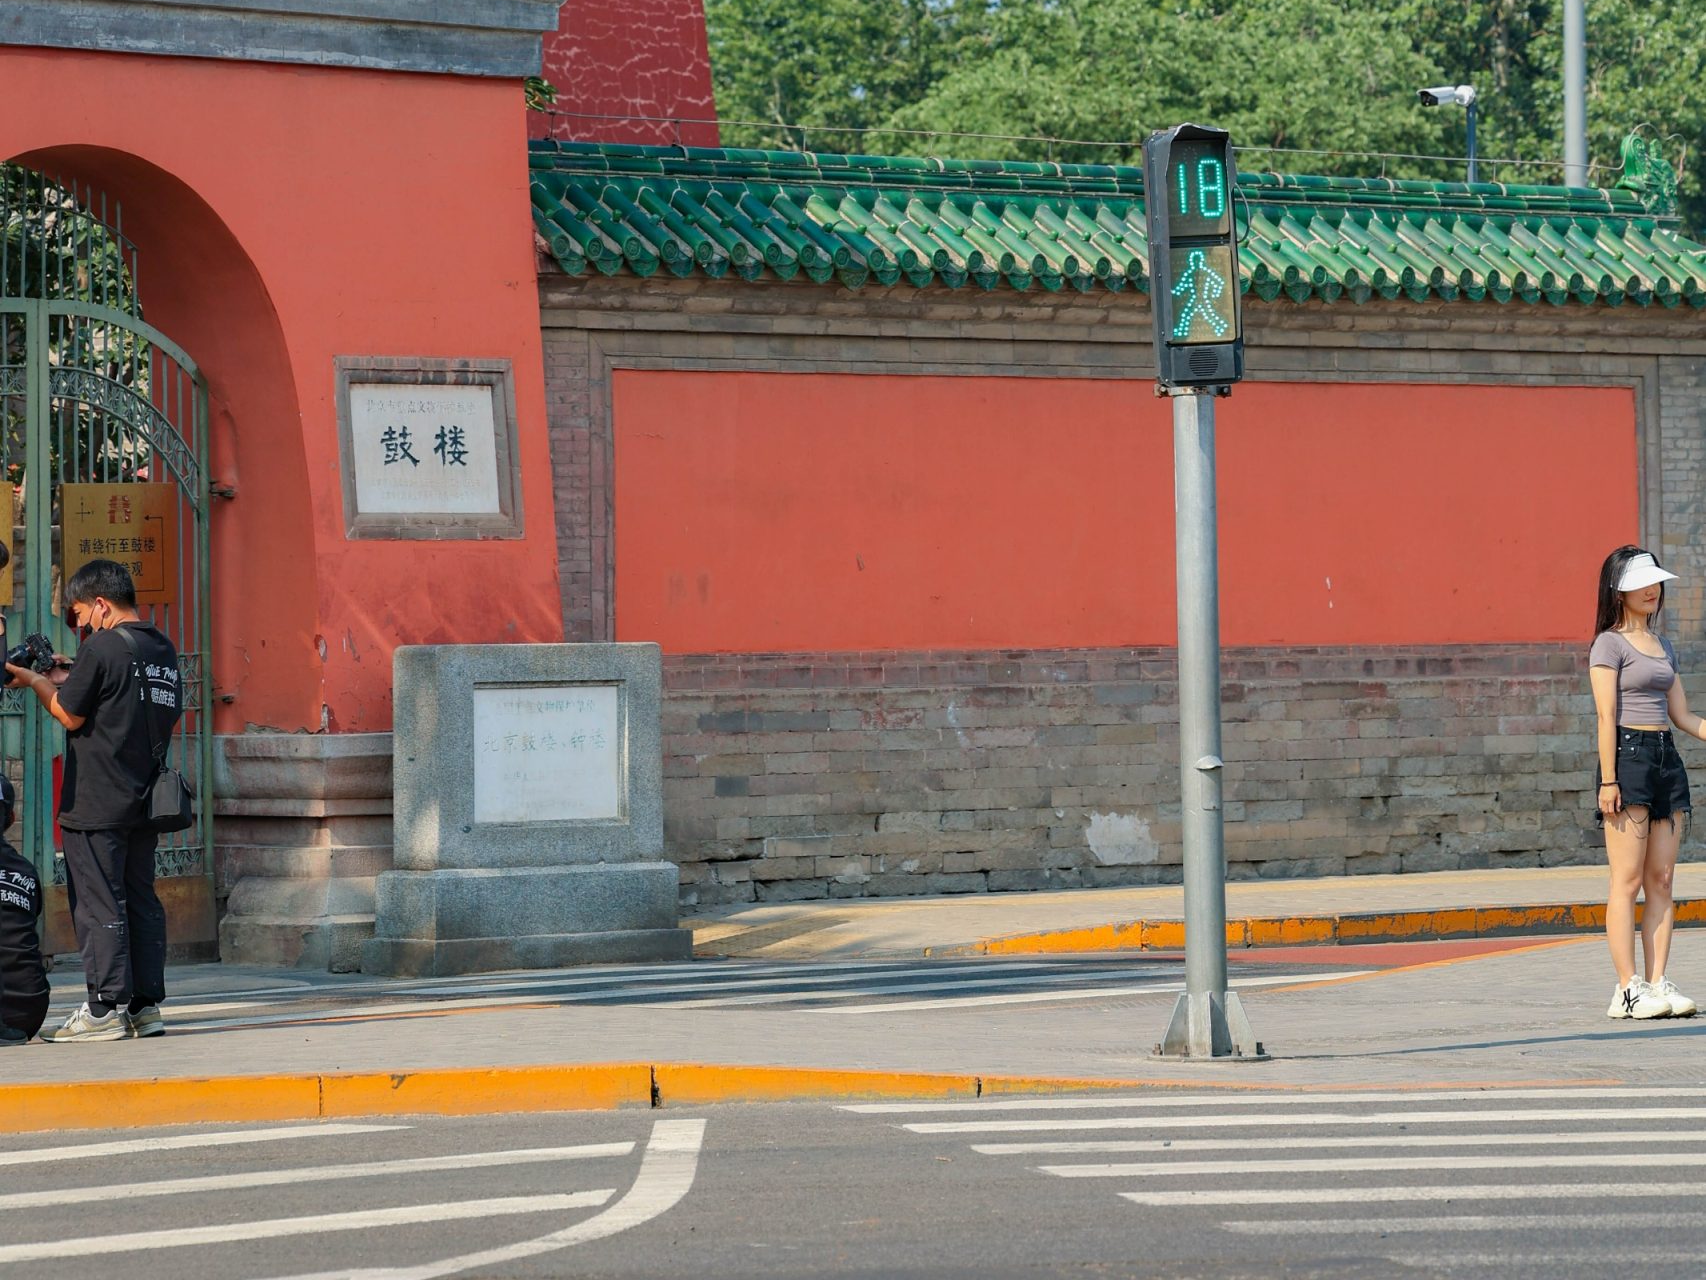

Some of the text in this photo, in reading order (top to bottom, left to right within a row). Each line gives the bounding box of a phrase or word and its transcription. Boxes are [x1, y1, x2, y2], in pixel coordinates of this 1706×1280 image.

[1179, 159, 1224, 216] 18
[380, 425, 469, 467] 鼓楼
[79, 537, 155, 554] 请绕行至鼓楼
